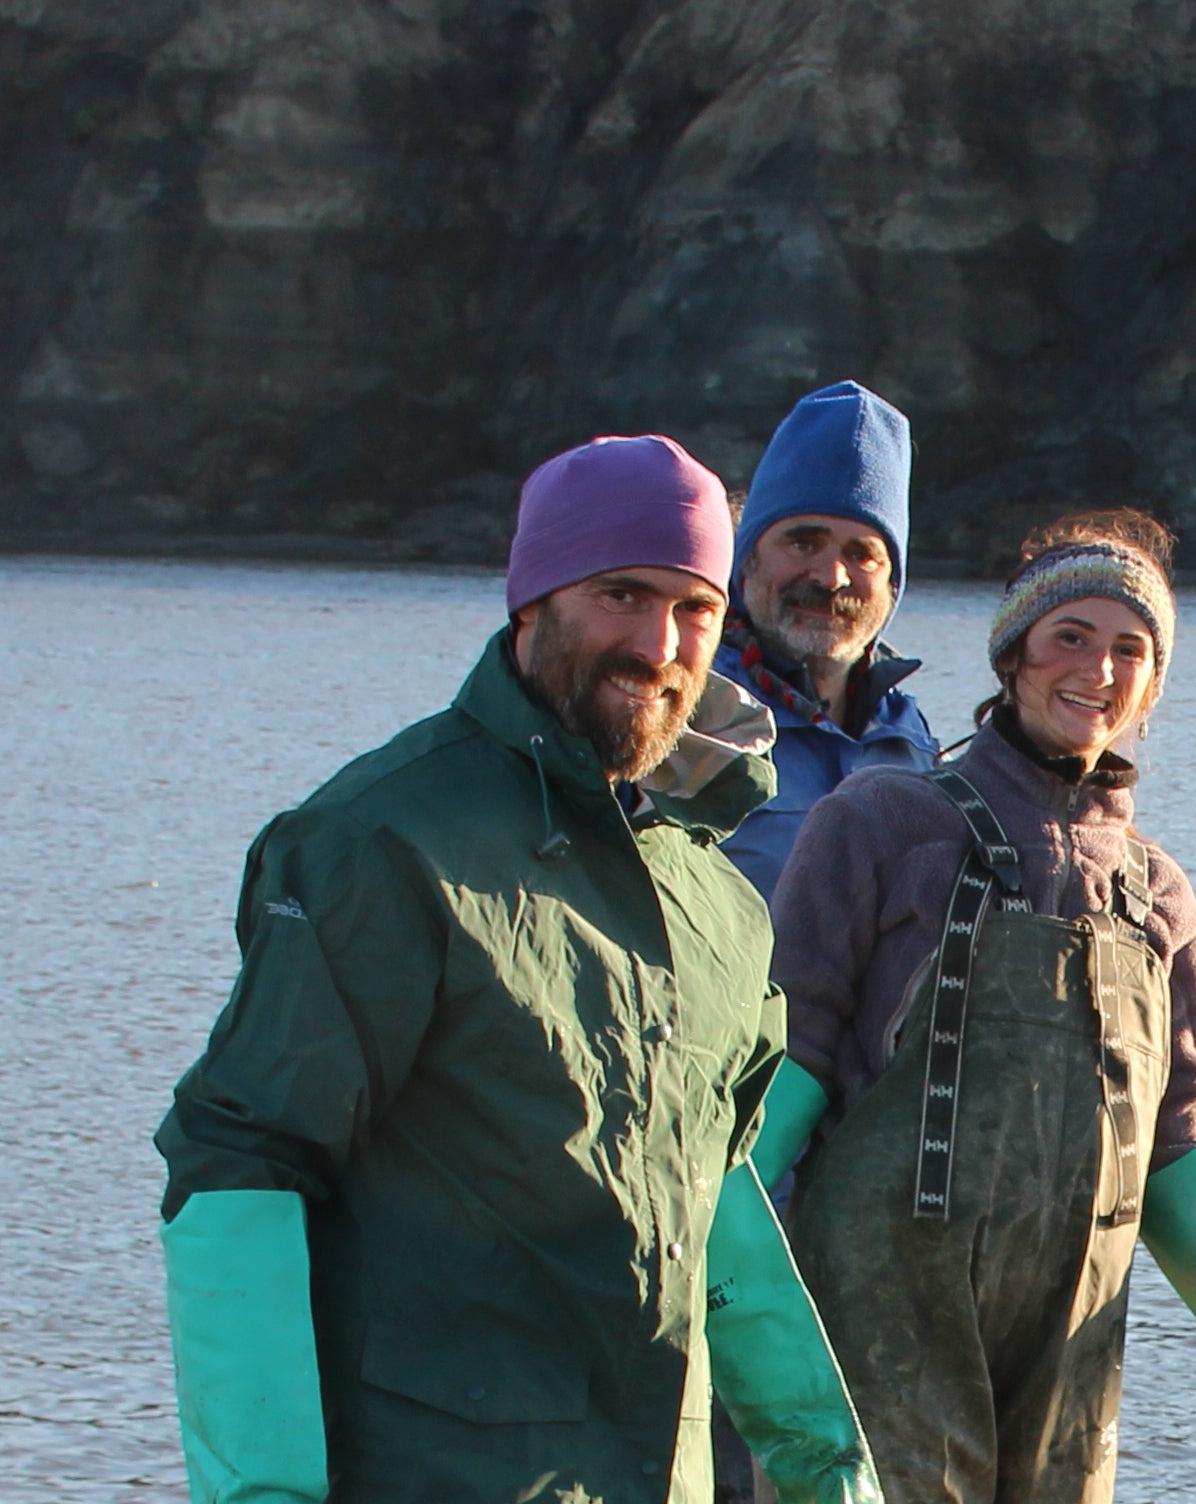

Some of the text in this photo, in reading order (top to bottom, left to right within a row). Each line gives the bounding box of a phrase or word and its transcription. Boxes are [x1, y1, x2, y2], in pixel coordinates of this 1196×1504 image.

[949, 921, 973, 935] HH
[941, 976, 964, 990] HH
[934, 1031, 959, 1045] HH
[929, 1084, 953, 1099] HH
[924, 1139, 949, 1153] HH
[920, 1192, 944, 1206] HH
